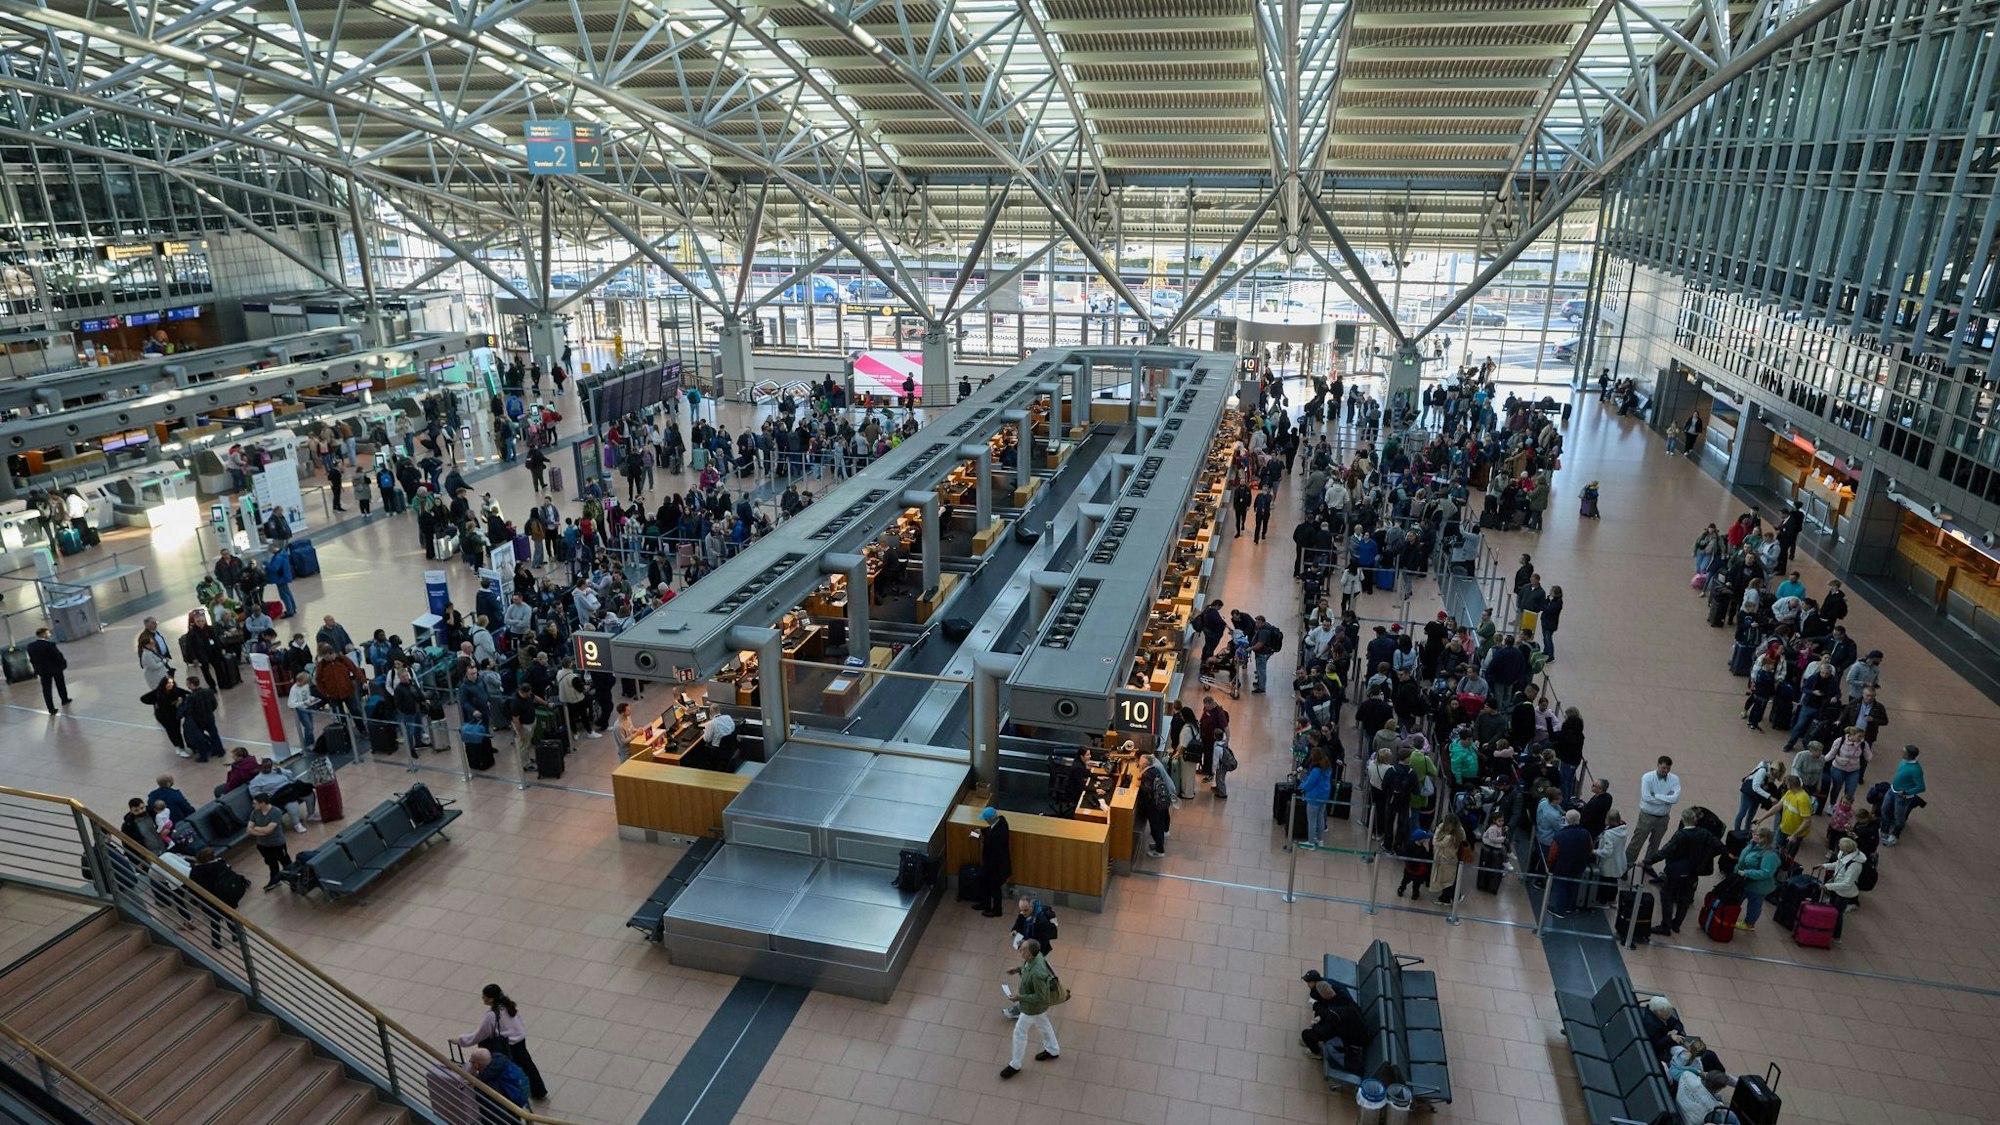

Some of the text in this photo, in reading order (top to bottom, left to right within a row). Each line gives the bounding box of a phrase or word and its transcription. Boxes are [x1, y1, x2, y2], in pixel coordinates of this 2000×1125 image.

[554, 145, 567, 167] 2
[591, 146, 600, 167] 2
[488, 336, 494, 344] 8
[1243, 359, 1254, 368] 10
[584, 641, 598, 661] 9
[1121, 700, 1149, 723] 10
